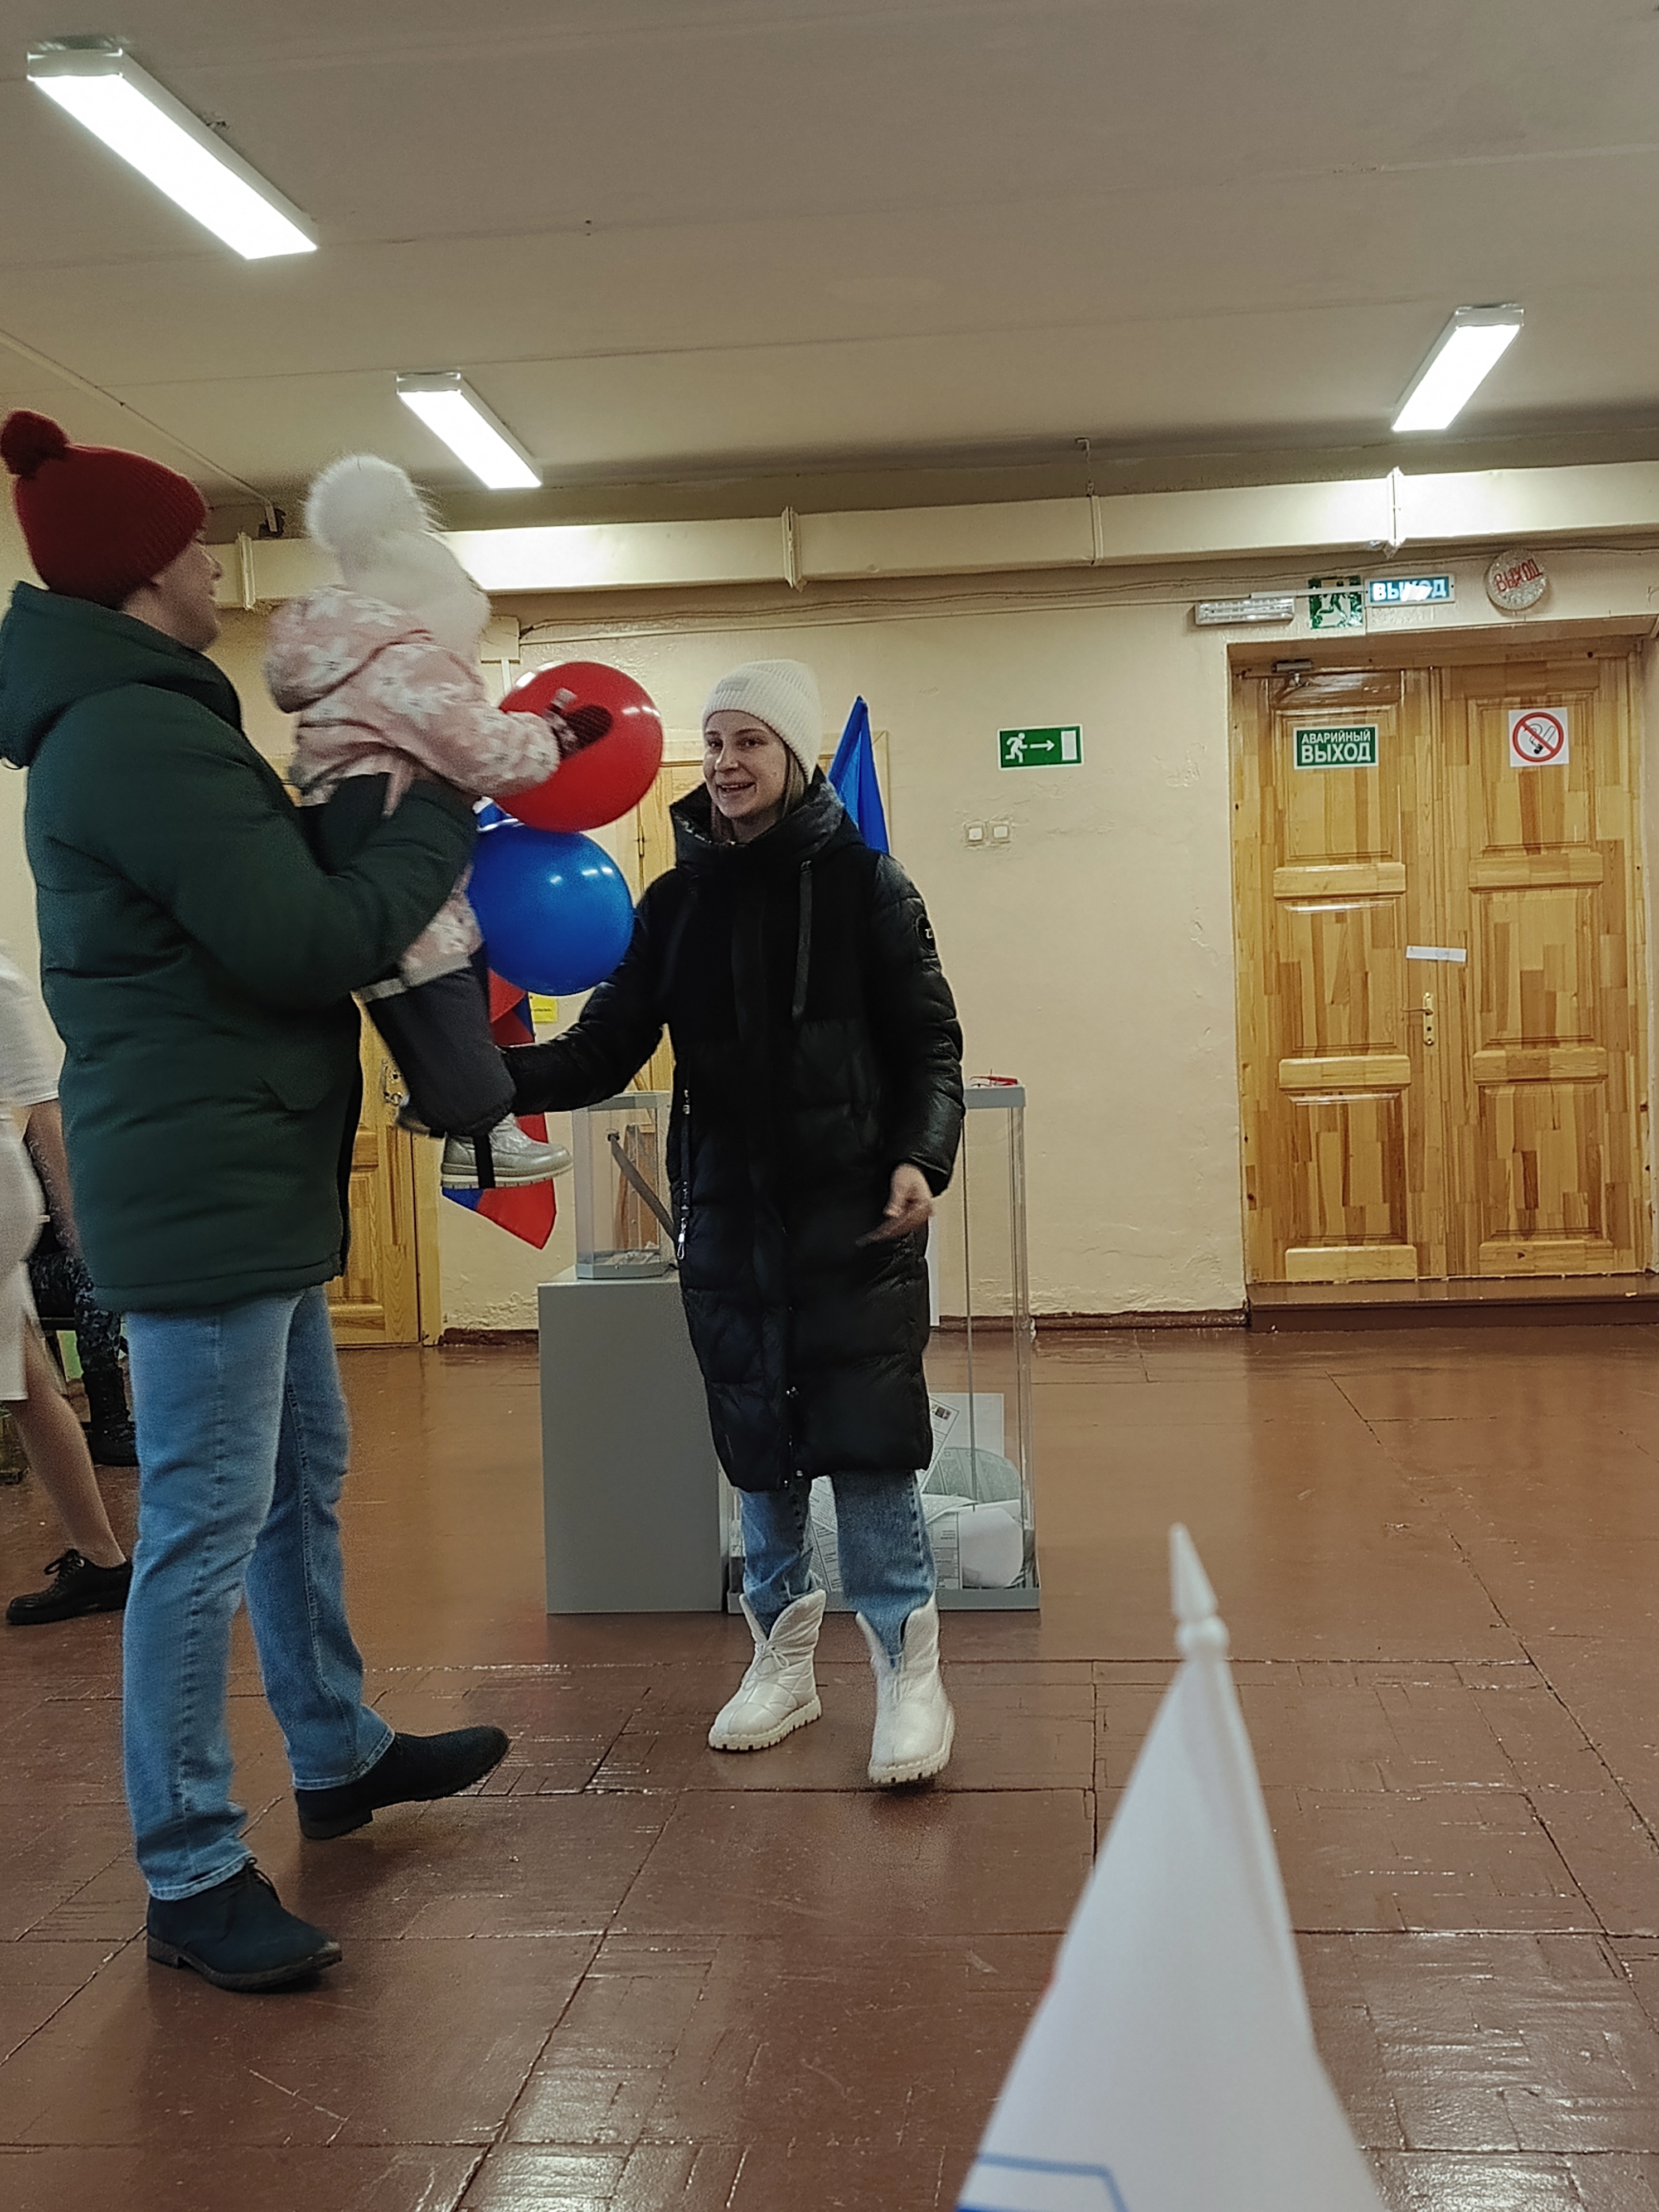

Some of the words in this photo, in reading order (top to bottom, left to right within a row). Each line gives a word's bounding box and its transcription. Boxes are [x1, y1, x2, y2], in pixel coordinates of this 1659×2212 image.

[1495, 559, 1543, 592] ВЫХОД
[1302, 729, 1371, 744] АВАРИЙНЫЙ
[1302, 742, 1371, 763] ВЫХОД
